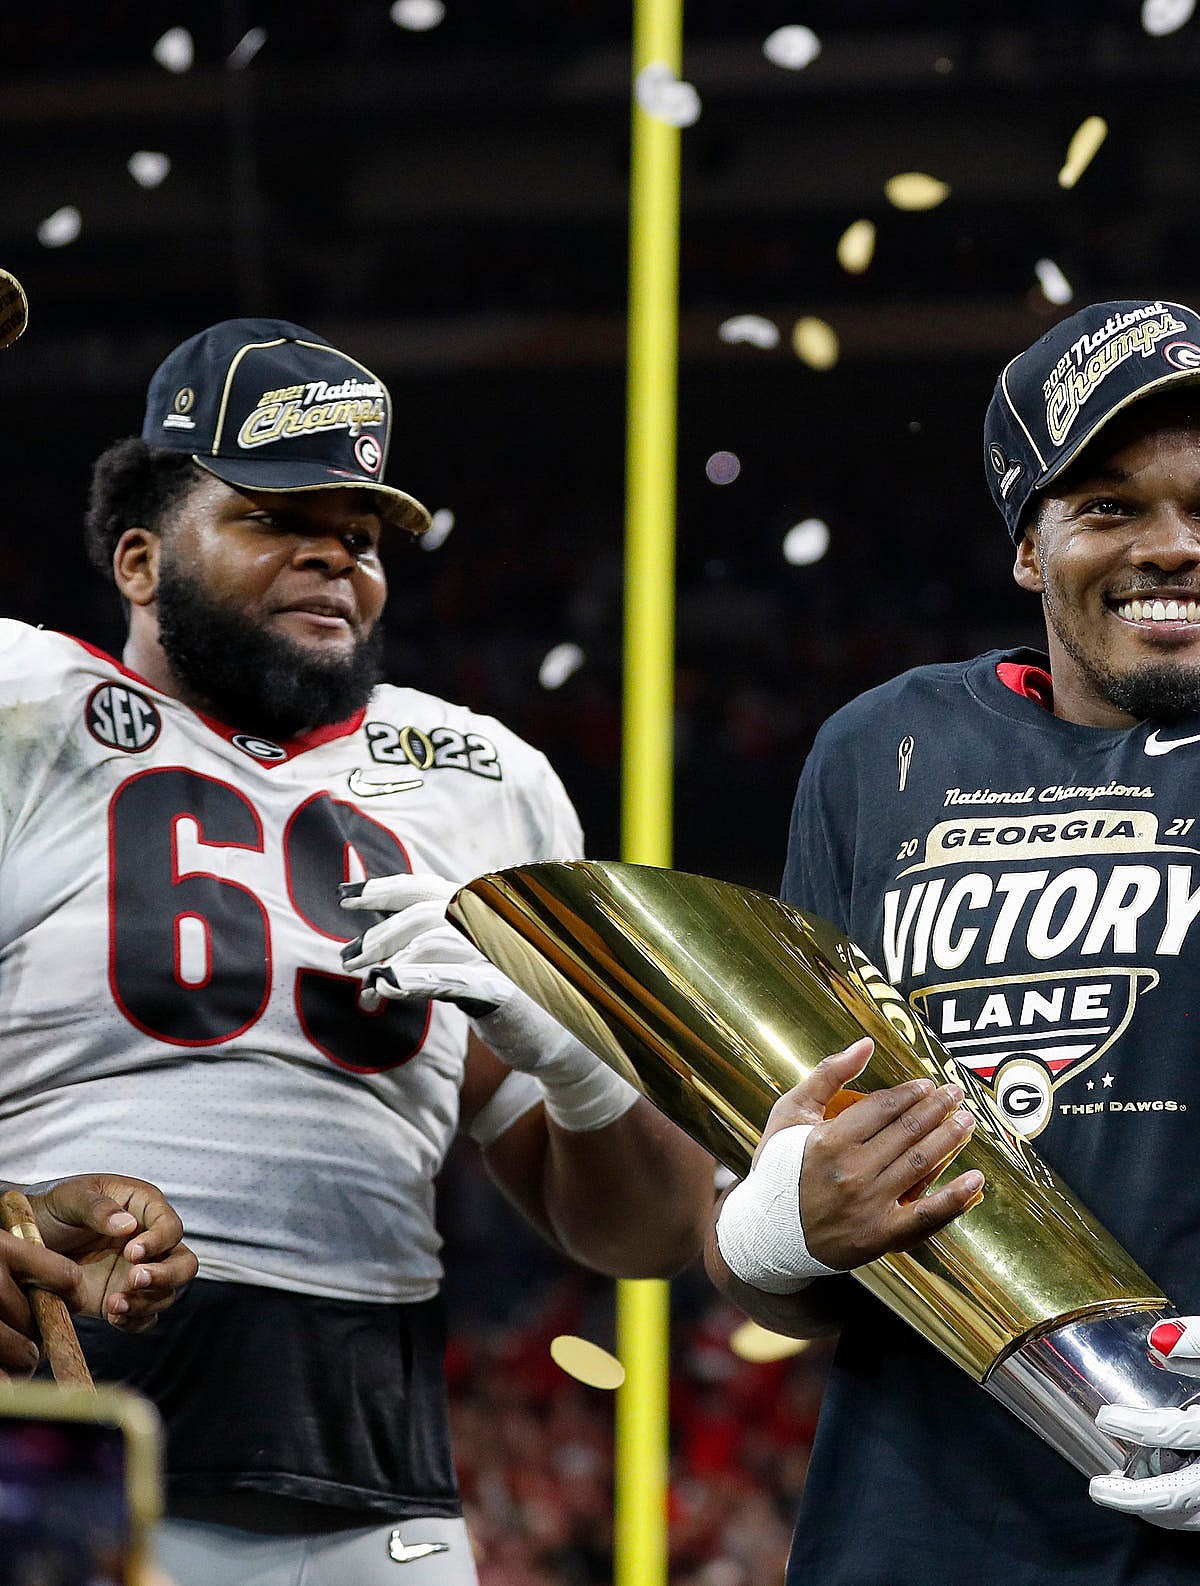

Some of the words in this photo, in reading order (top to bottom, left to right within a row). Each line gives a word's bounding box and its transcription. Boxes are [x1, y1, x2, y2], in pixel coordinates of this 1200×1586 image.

[1069, 302, 1168, 362] National
[1046, 312, 1187, 446] Champs
[92, 686, 157, 747] SEC
[365, 721, 502, 781] 2022
[943, 785, 1036, 807] National
[1038, 780, 1155, 803] Champions
[896, 838, 919, 861] 20
[941, 820, 1137, 849] GEORGIA
[1165, 818, 1196, 837] 21
[108, 766, 432, 1074] 69
[941, 983, 1112, 1035] LANE
[1059, 1102, 1105, 1116] THEM
[1109, 1099, 1180, 1114] DAWGS
